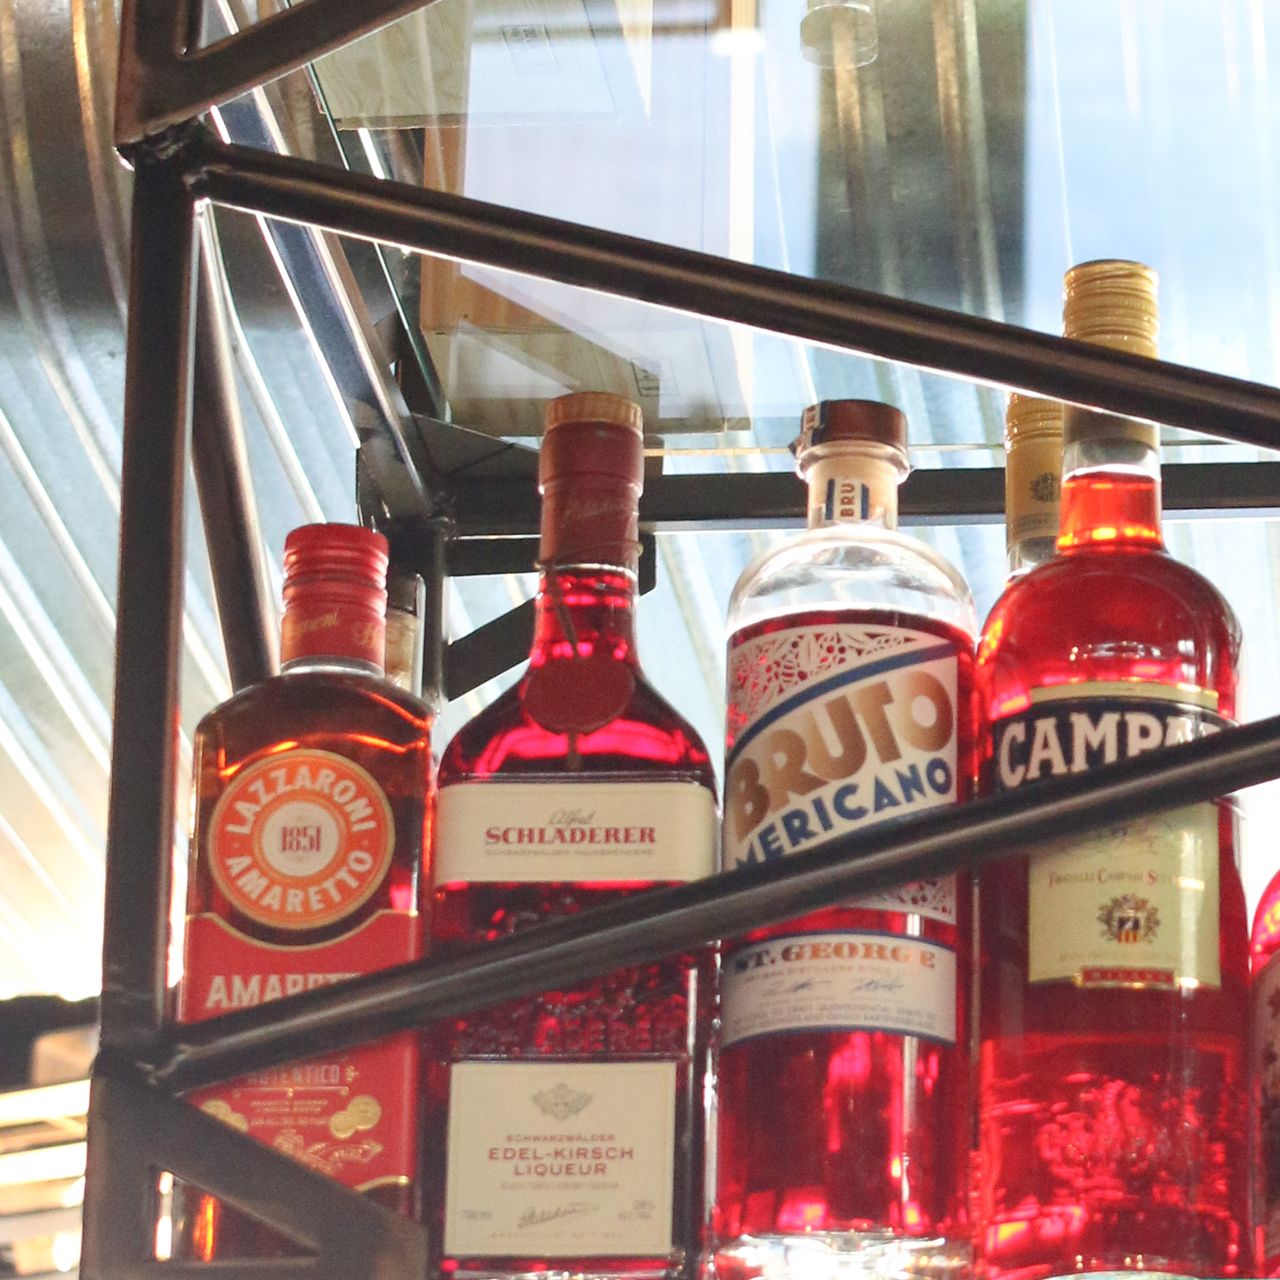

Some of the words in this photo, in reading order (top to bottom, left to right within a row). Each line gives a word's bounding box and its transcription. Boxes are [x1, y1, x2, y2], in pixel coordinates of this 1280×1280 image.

[733, 670, 954, 844] BRUTO
[225, 765, 378, 836] LAZZARONI
[484, 826, 657, 846] SCHLADERER
[224, 850, 374, 913] AMARETTO
[781, 940, 936, 970] GEORGE
[488, 1147, 635, 1161] EDEL-KIRSCH
[513, 1163, 608, 1177] LIQUEUR
